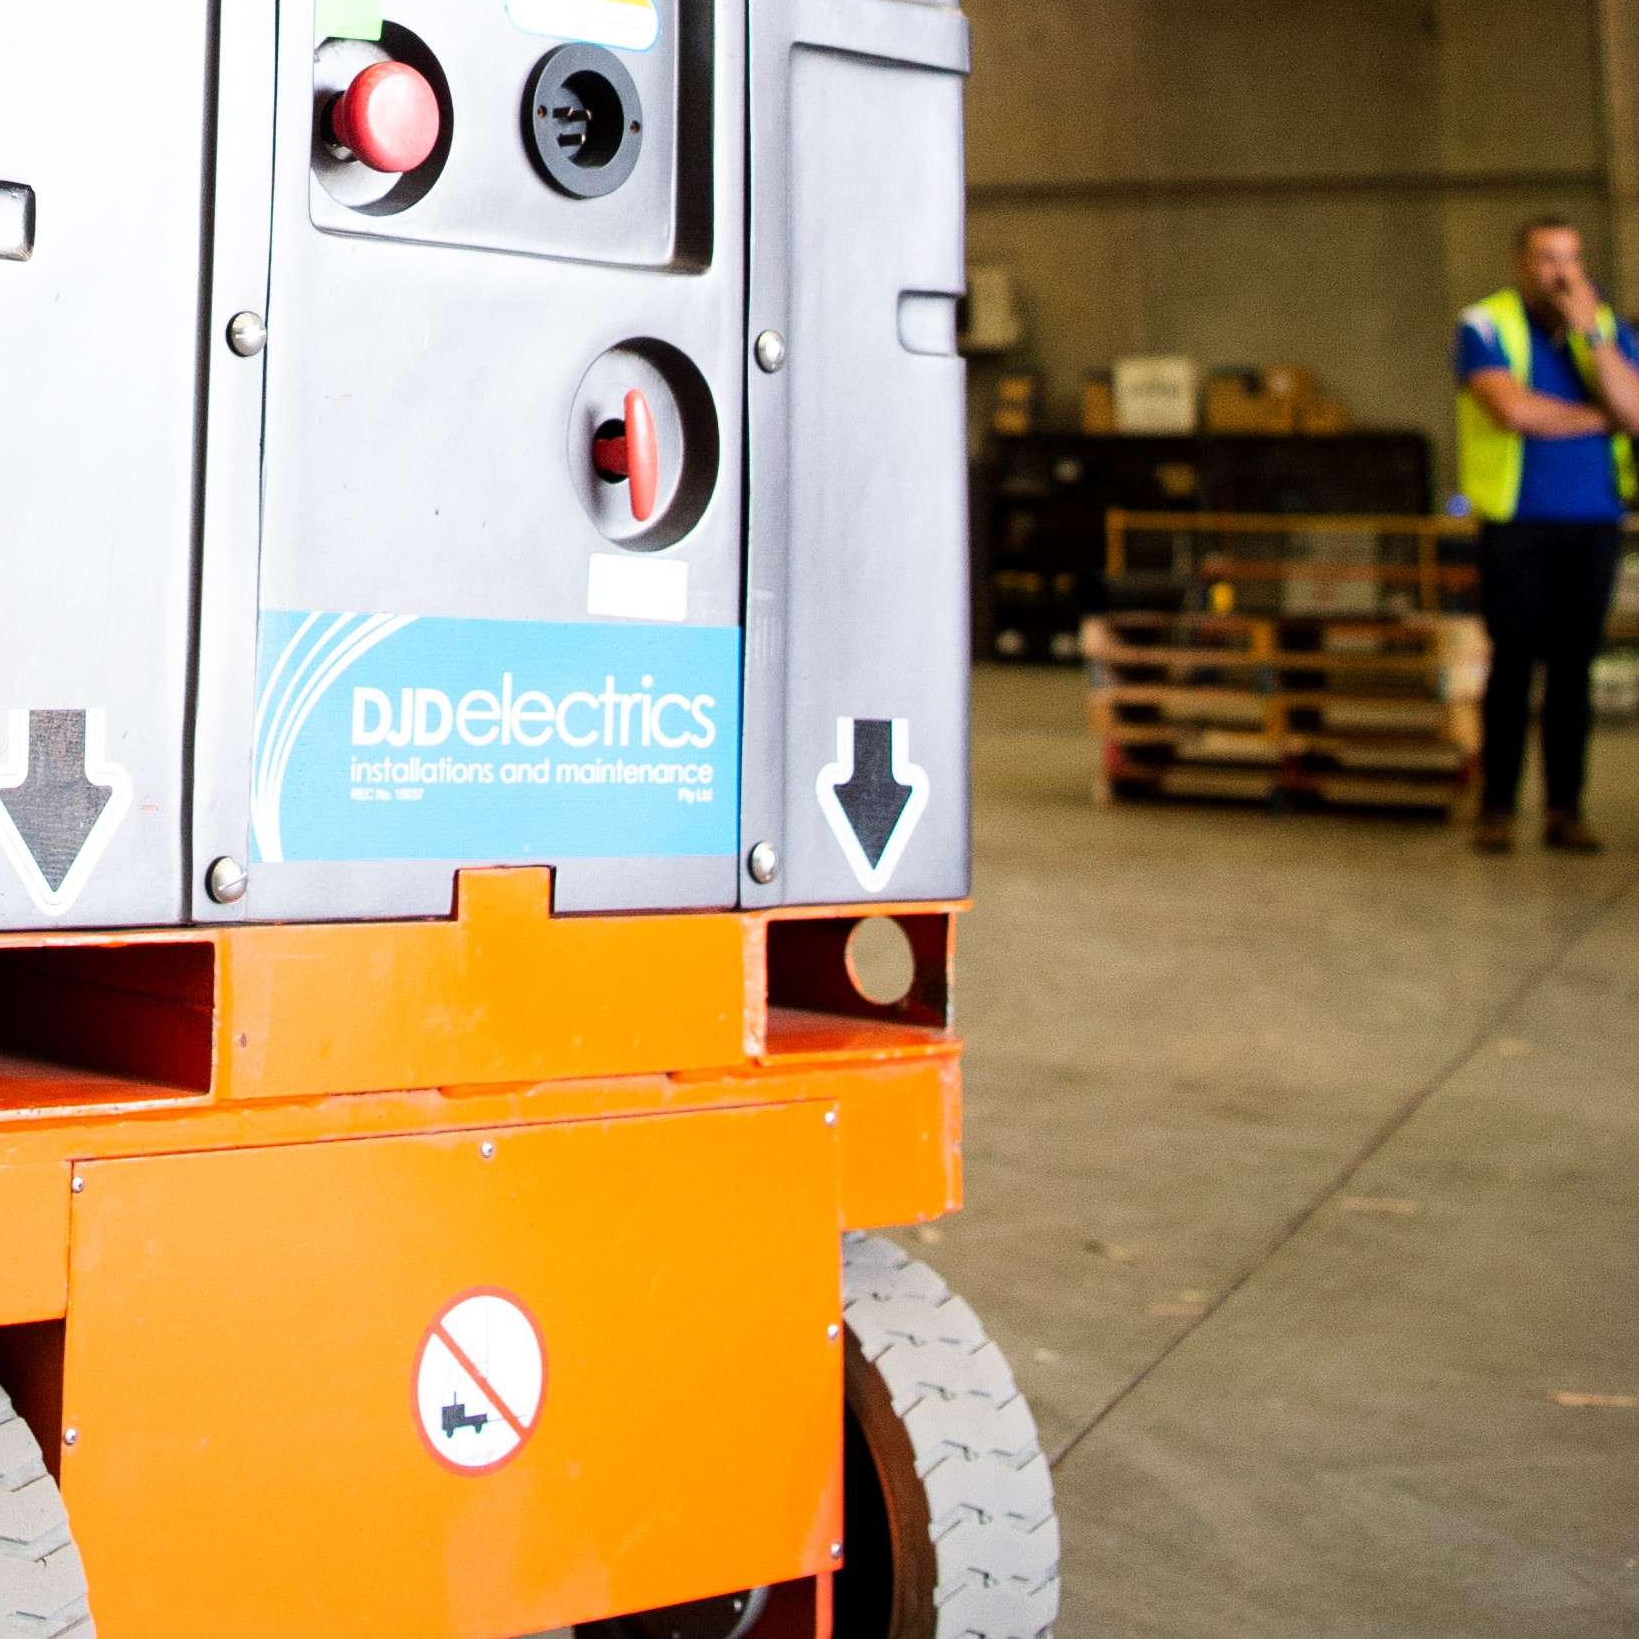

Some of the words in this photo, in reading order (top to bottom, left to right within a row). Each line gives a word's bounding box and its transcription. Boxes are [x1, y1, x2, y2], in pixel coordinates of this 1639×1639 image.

[350, 757, 494, 784] installations
[500, 758, 550, 785] and
[556, 758, 715, 785] maintenance
